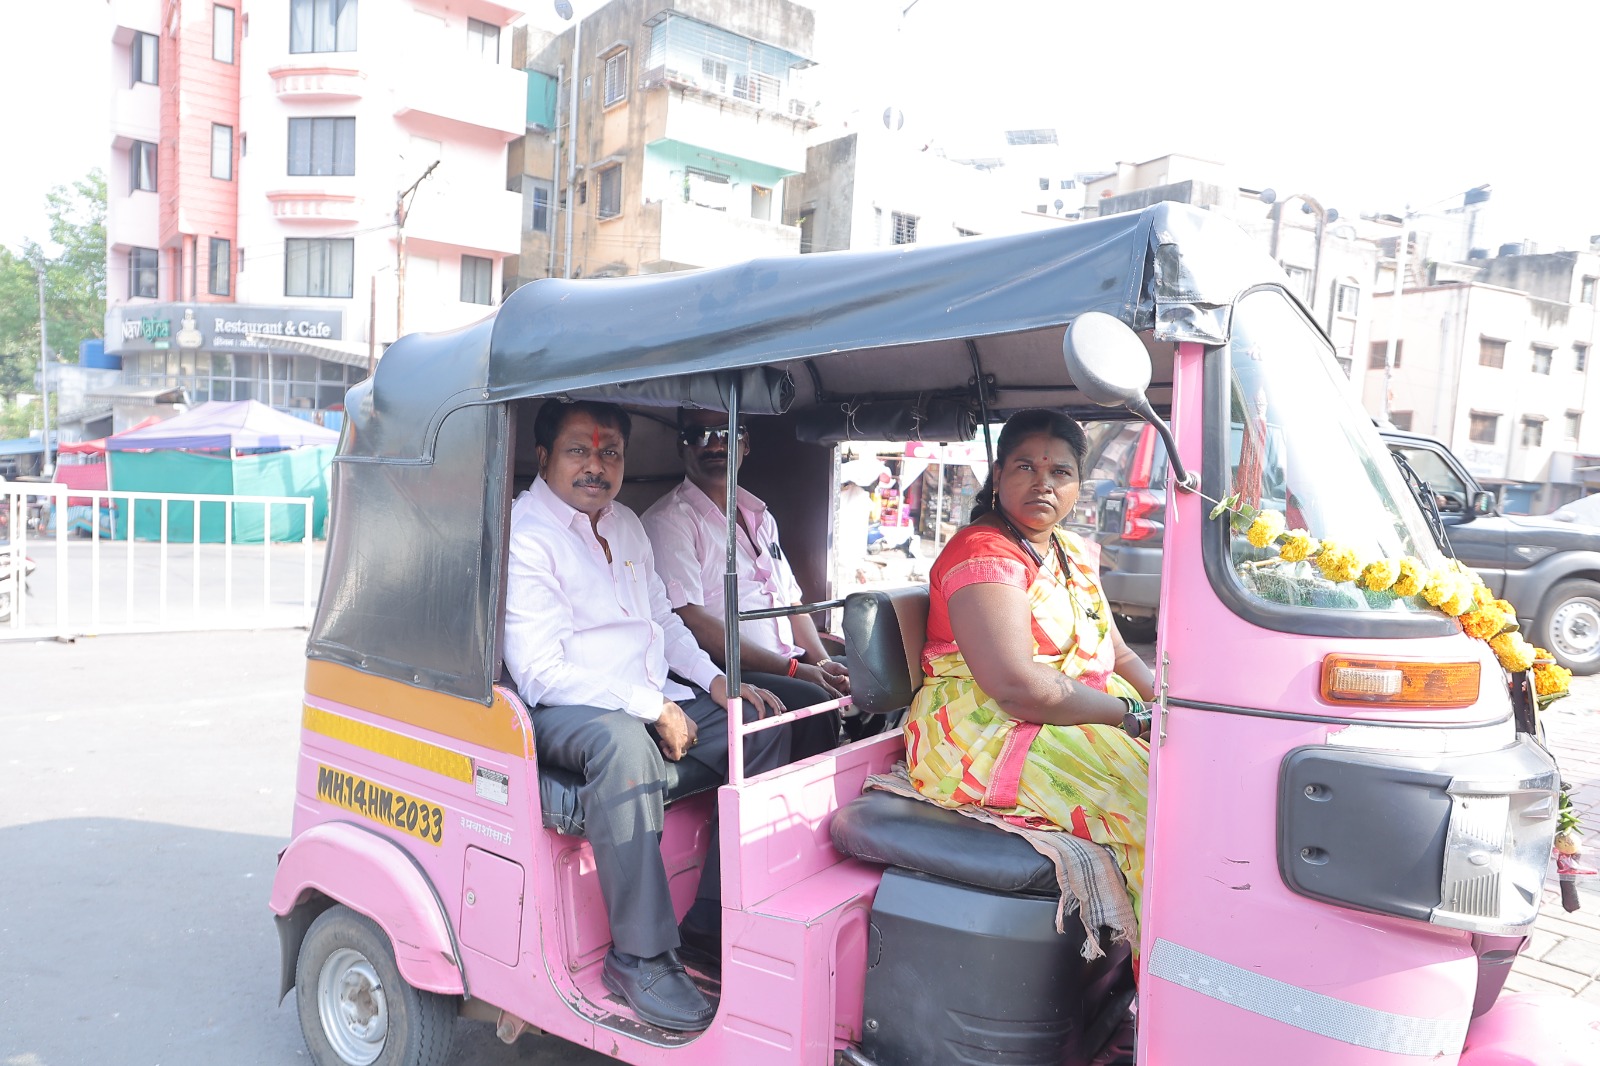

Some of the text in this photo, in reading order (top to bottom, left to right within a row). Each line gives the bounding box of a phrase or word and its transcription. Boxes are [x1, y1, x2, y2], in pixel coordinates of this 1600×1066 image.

[214, 317, 332, 337] Restaurant & Cafe
